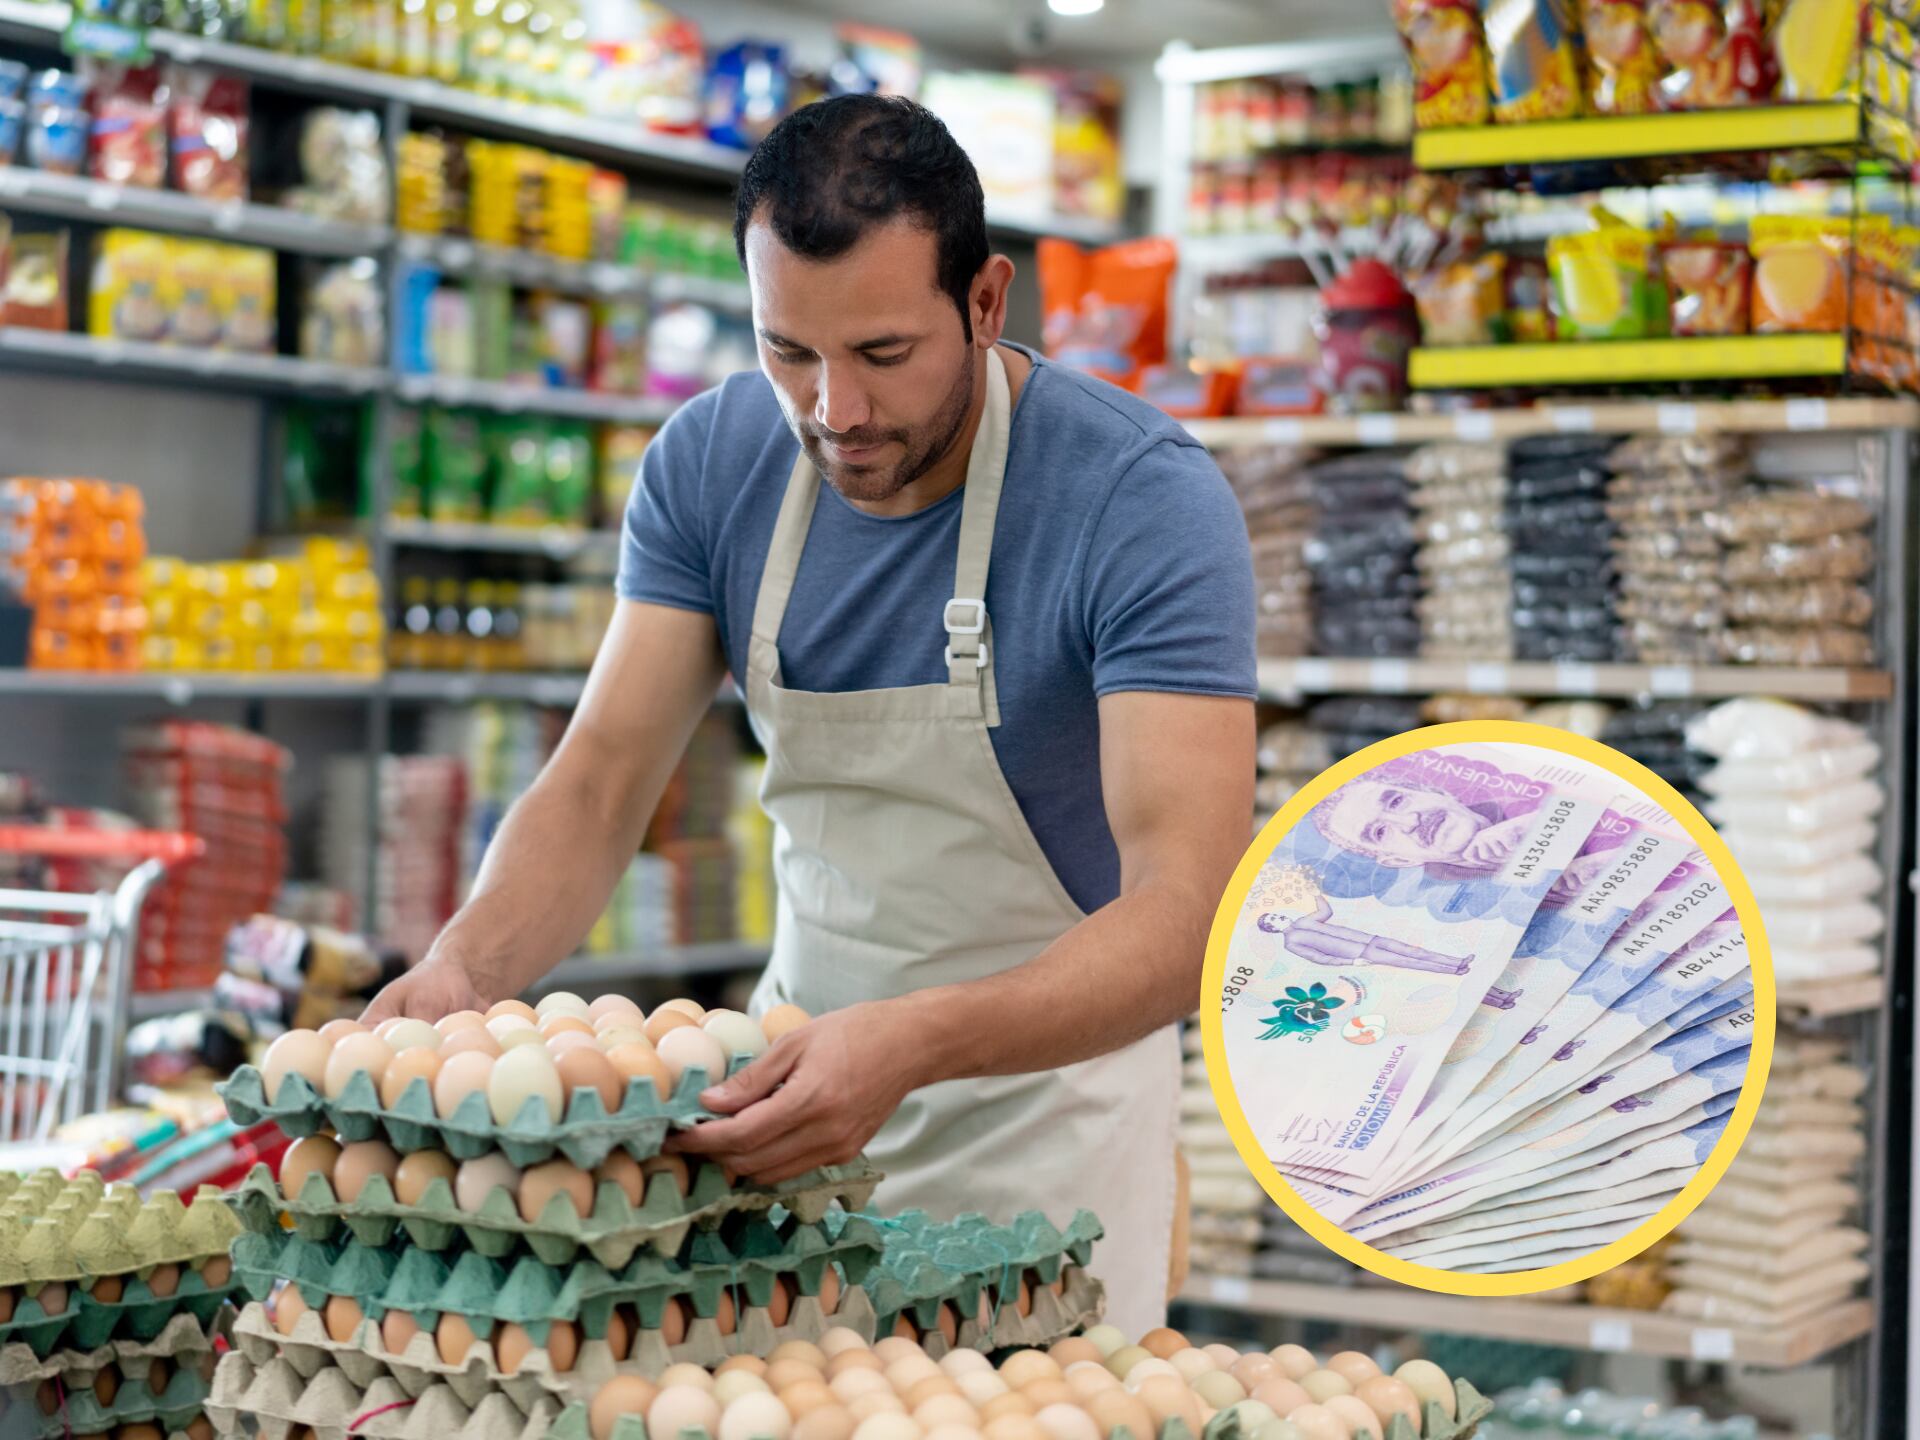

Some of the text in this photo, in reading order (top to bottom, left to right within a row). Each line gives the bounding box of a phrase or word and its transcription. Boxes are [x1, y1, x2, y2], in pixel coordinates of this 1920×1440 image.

[1422, 755, 1544, 799] CINCUENTA
[1514, 800, 1576, 879] AA33643808
[1580, 837, 1660, 914] AA49855880
[1623, 882, 1717, 956] AA19189202
[1728, 1008, 1755, 1029] AB
[1333, 1118, 1362, 1149] BANCO
[1355, 1104, 1371, 1117] DE
[1364, 1091, 1378, 1106] LA
[1372, 1044, 1408, 1091] REPÚBLICA
[1349, 1089, 1401, 1150] COLOMBIA
